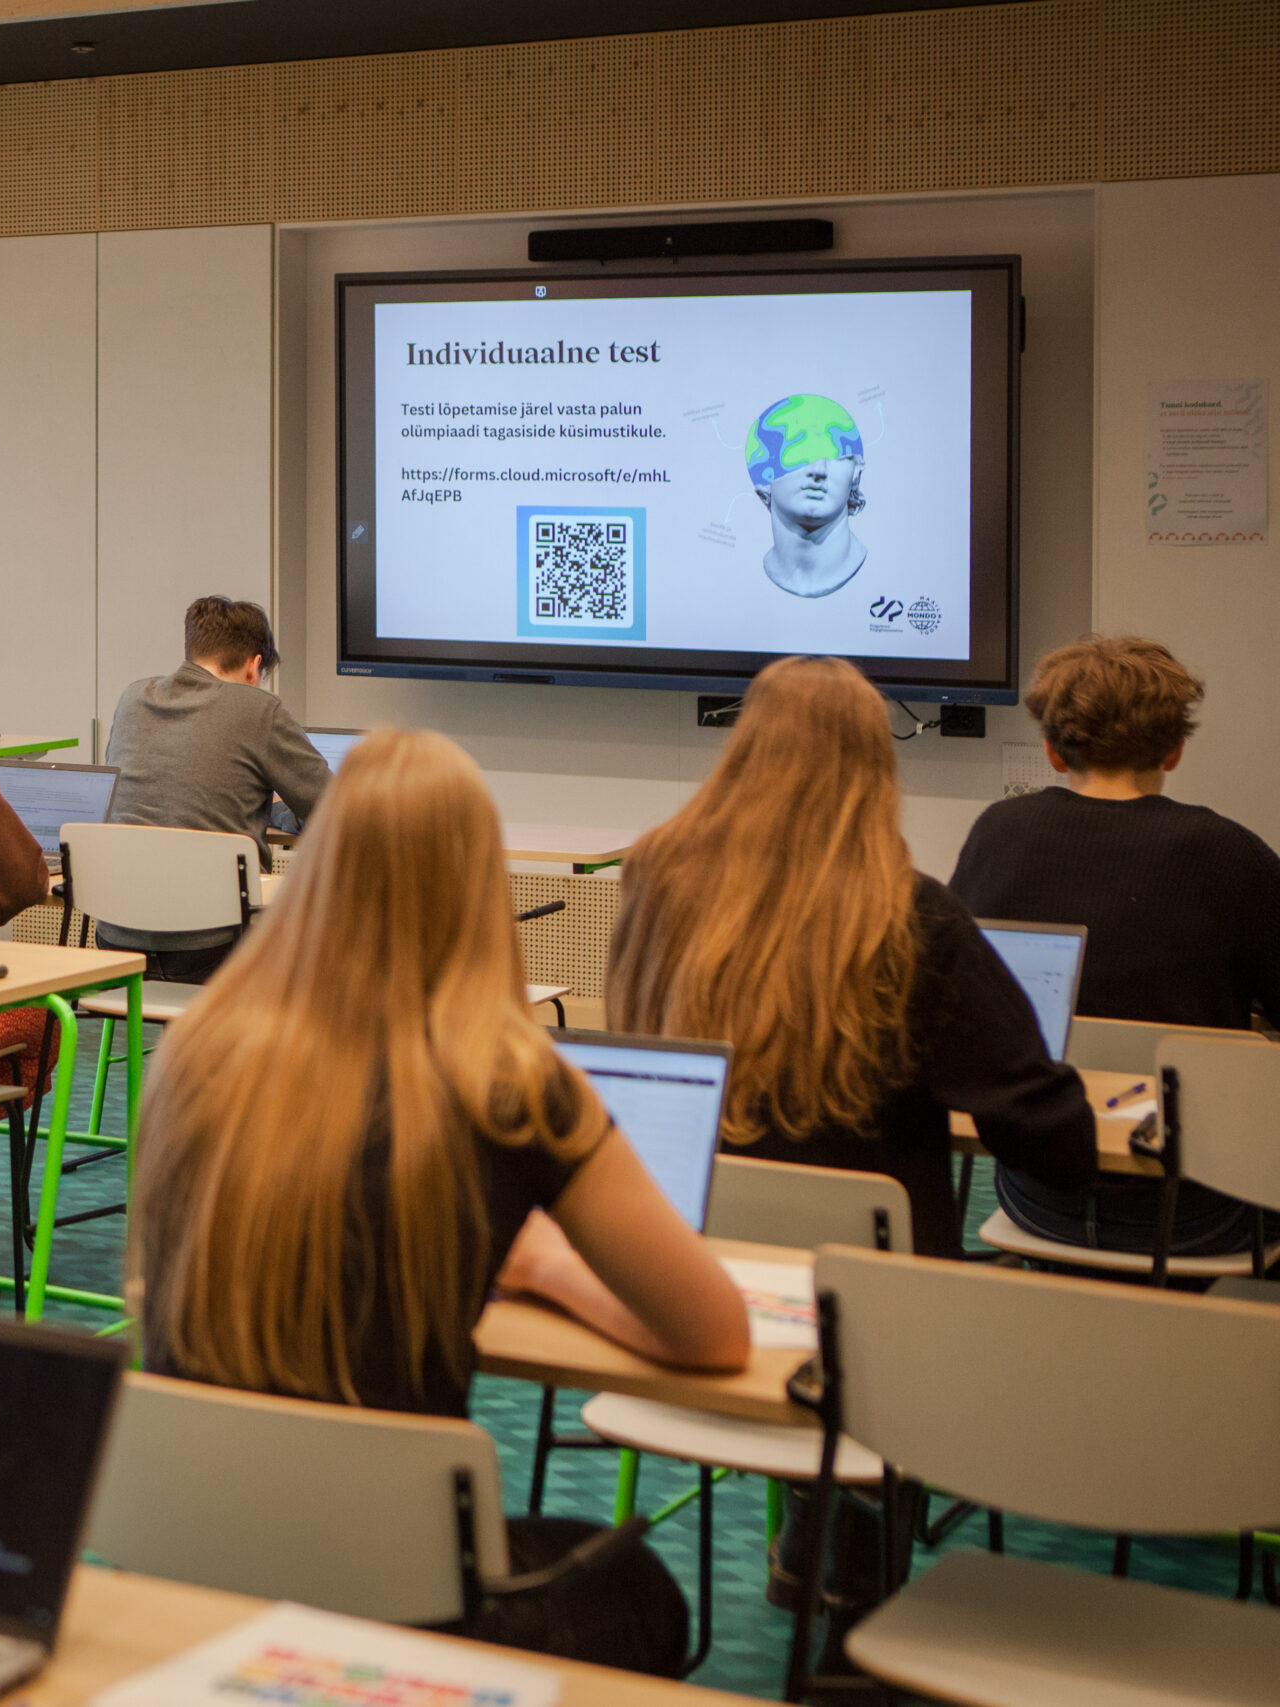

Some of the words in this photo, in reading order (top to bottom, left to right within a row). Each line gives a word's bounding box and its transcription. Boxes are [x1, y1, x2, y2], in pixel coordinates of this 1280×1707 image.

[406, 340, 600, 365] Individuaalne
[609, 340, 662, 364] test
[401, 403, 435, 416] Testi
[438, 403, 517, 418] lõpetamise
[520, 402, 553, 418] järel
[557, 404, 596, 416] vasta
[600, 402, 642, 418] palun
[401, 425, 480, 440] olümpiaadi
[483, 425, 556, 441] tagasiside
[559, 425, 667, 438] küsimustikule.
[401, 467, 671, 483] https://forms.cloud.microsoft/e/mhL
[401, 489, 462, 504] AfJqEPB
